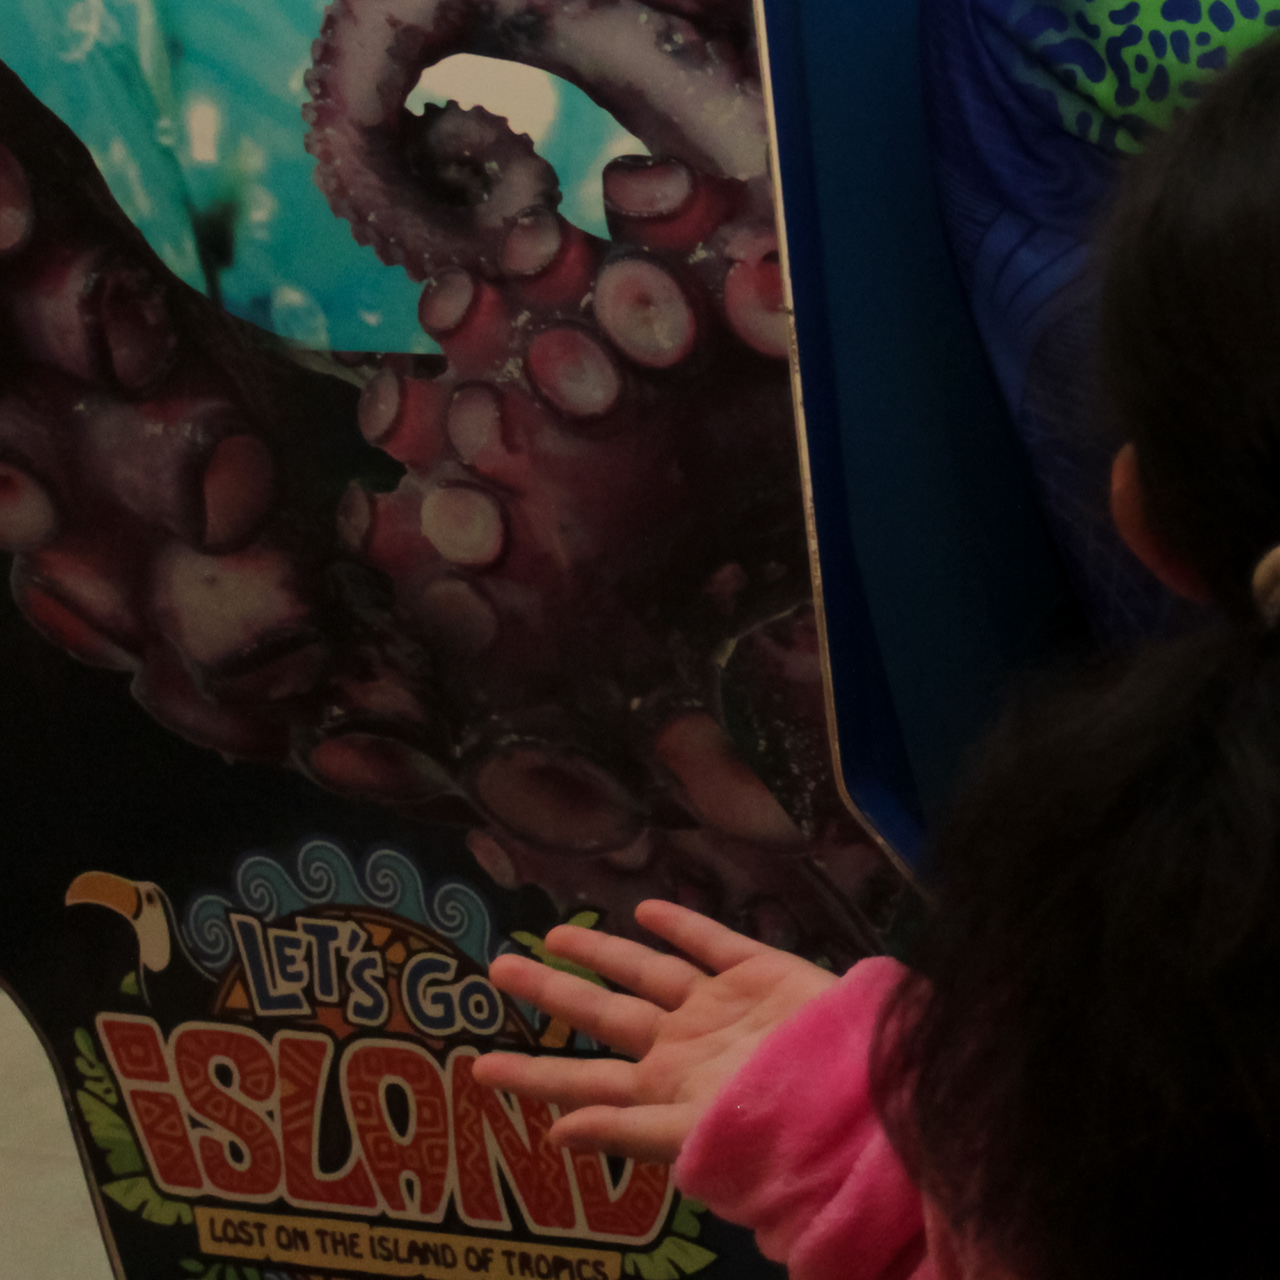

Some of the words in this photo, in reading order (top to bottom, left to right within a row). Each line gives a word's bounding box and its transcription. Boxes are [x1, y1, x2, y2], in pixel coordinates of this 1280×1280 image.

[230, 913, 389, 1026] LET'S
[402, 951, 504, 1035] GO
[208, 1216, 267, 1248] LOST
[275, 1224, 309, 1251] ON
[314, 1228, 364, 1259] THE
[369, 1235, 457, 1270] ISLAND
[464, 1245, 496, 1272] OF
[501, 1249, 608, 1280] TROPICS
